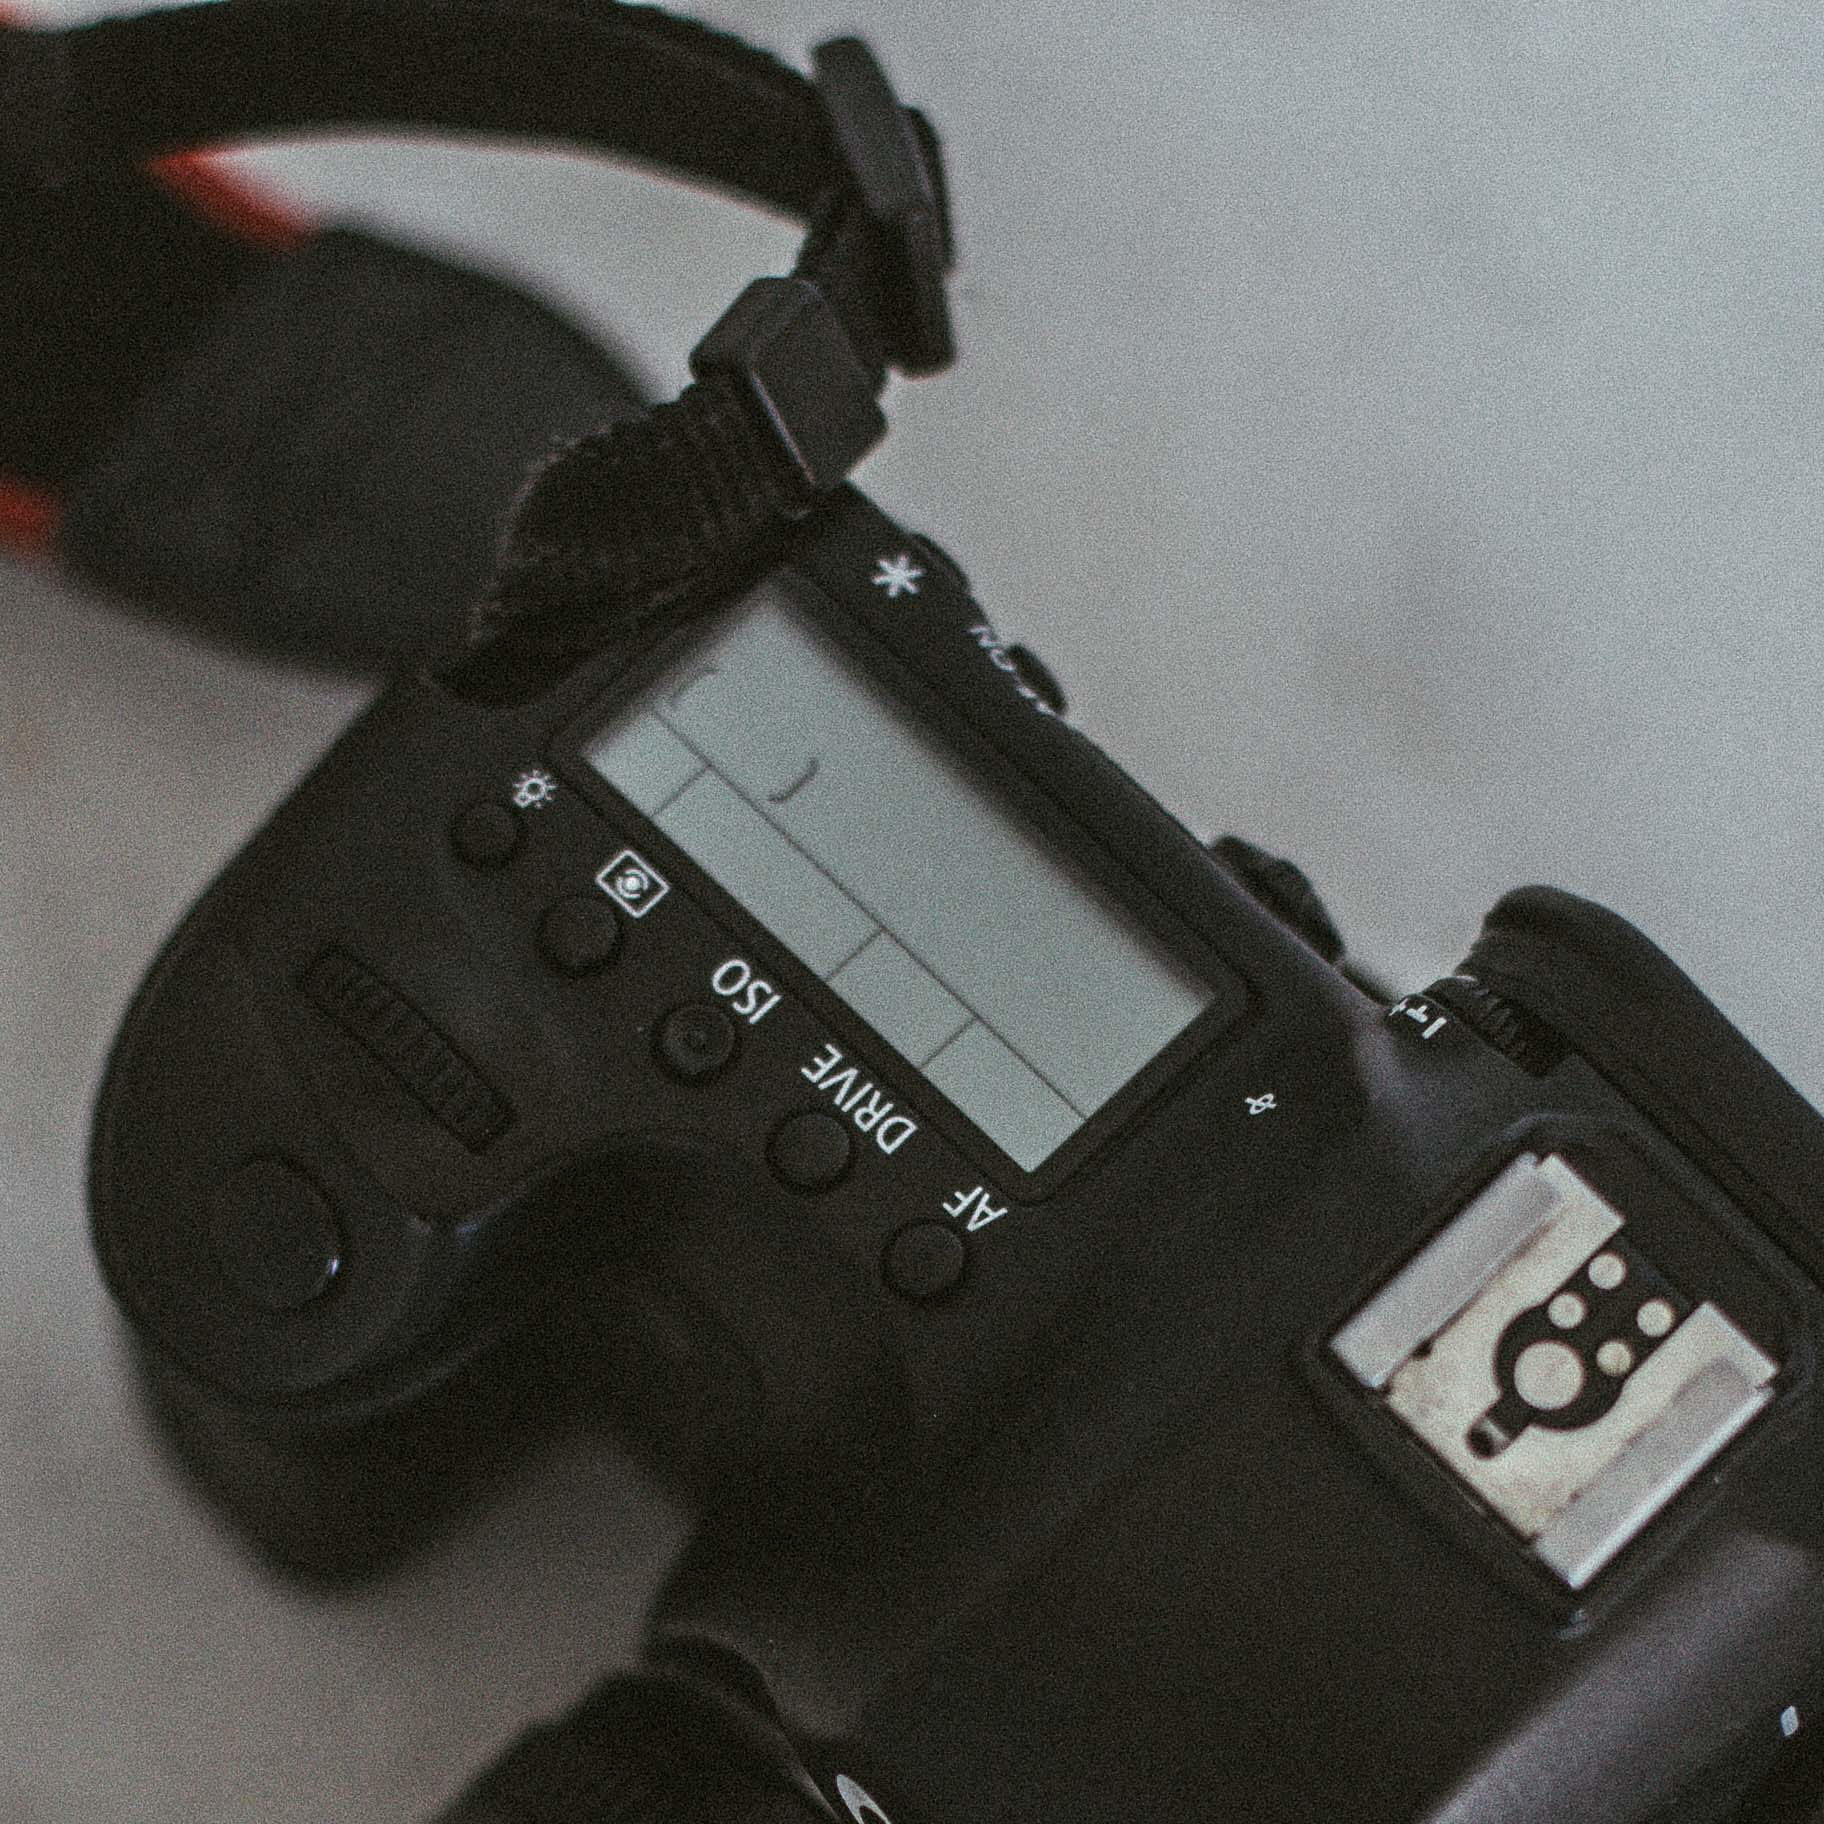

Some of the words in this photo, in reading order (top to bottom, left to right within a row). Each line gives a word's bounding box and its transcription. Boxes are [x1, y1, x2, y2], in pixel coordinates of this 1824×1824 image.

[712, 957, 781, 1023] ISO
[801, 1044, 918, 1155] DRIVE
[942, 1185, 1008, 1232] AF
